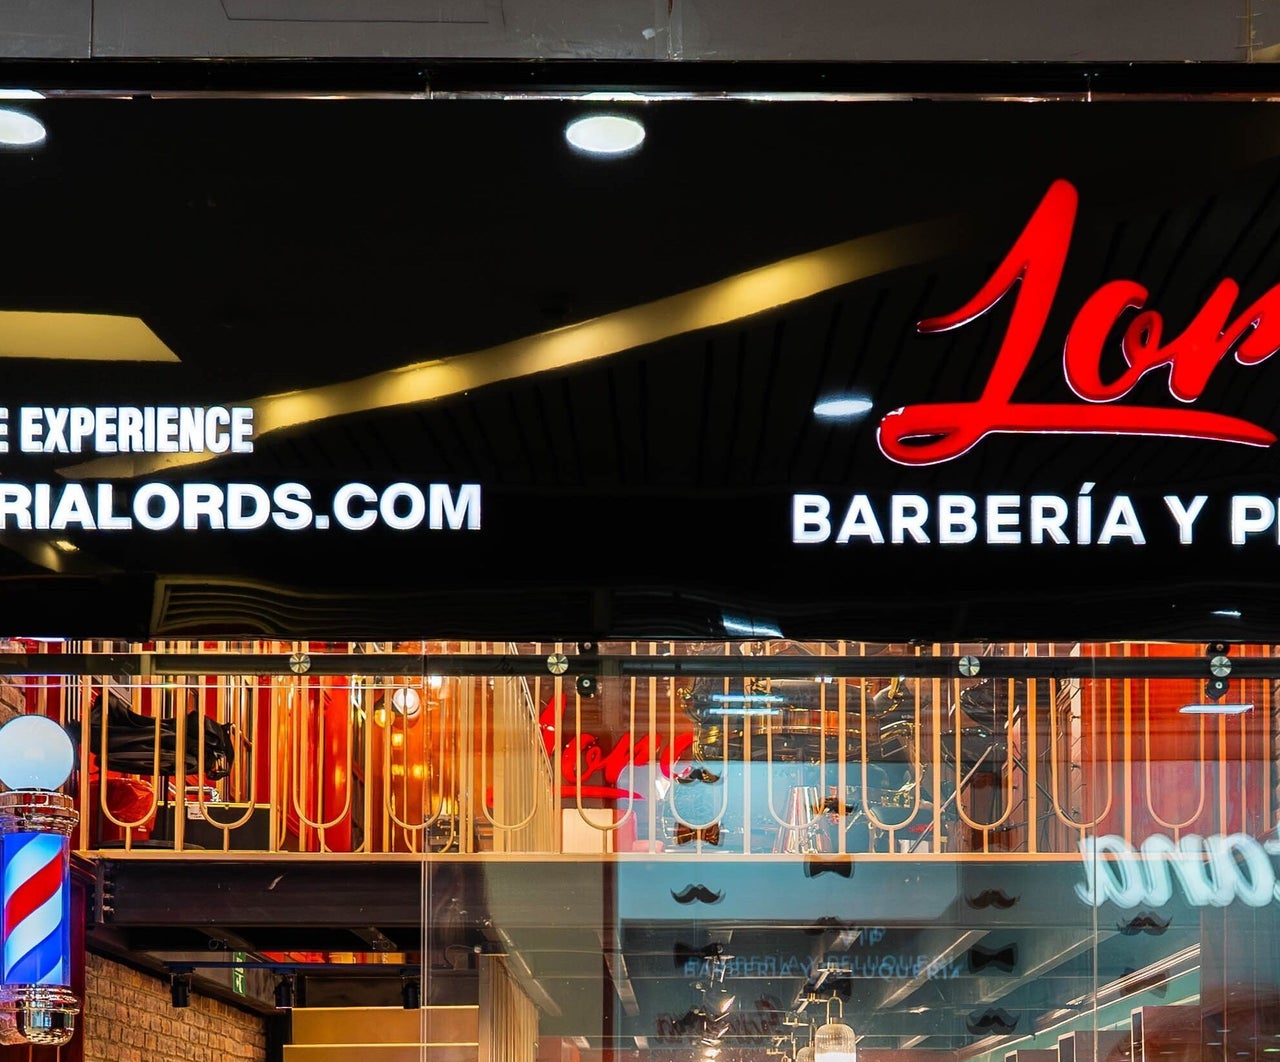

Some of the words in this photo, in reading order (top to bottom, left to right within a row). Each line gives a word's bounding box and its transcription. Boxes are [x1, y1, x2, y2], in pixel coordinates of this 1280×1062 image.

[21, 406, 254, 453] EXPERIENCE
[792, 482, 1146, 546] BARBERÍA
[1164, 495, 1209, 545] Y
